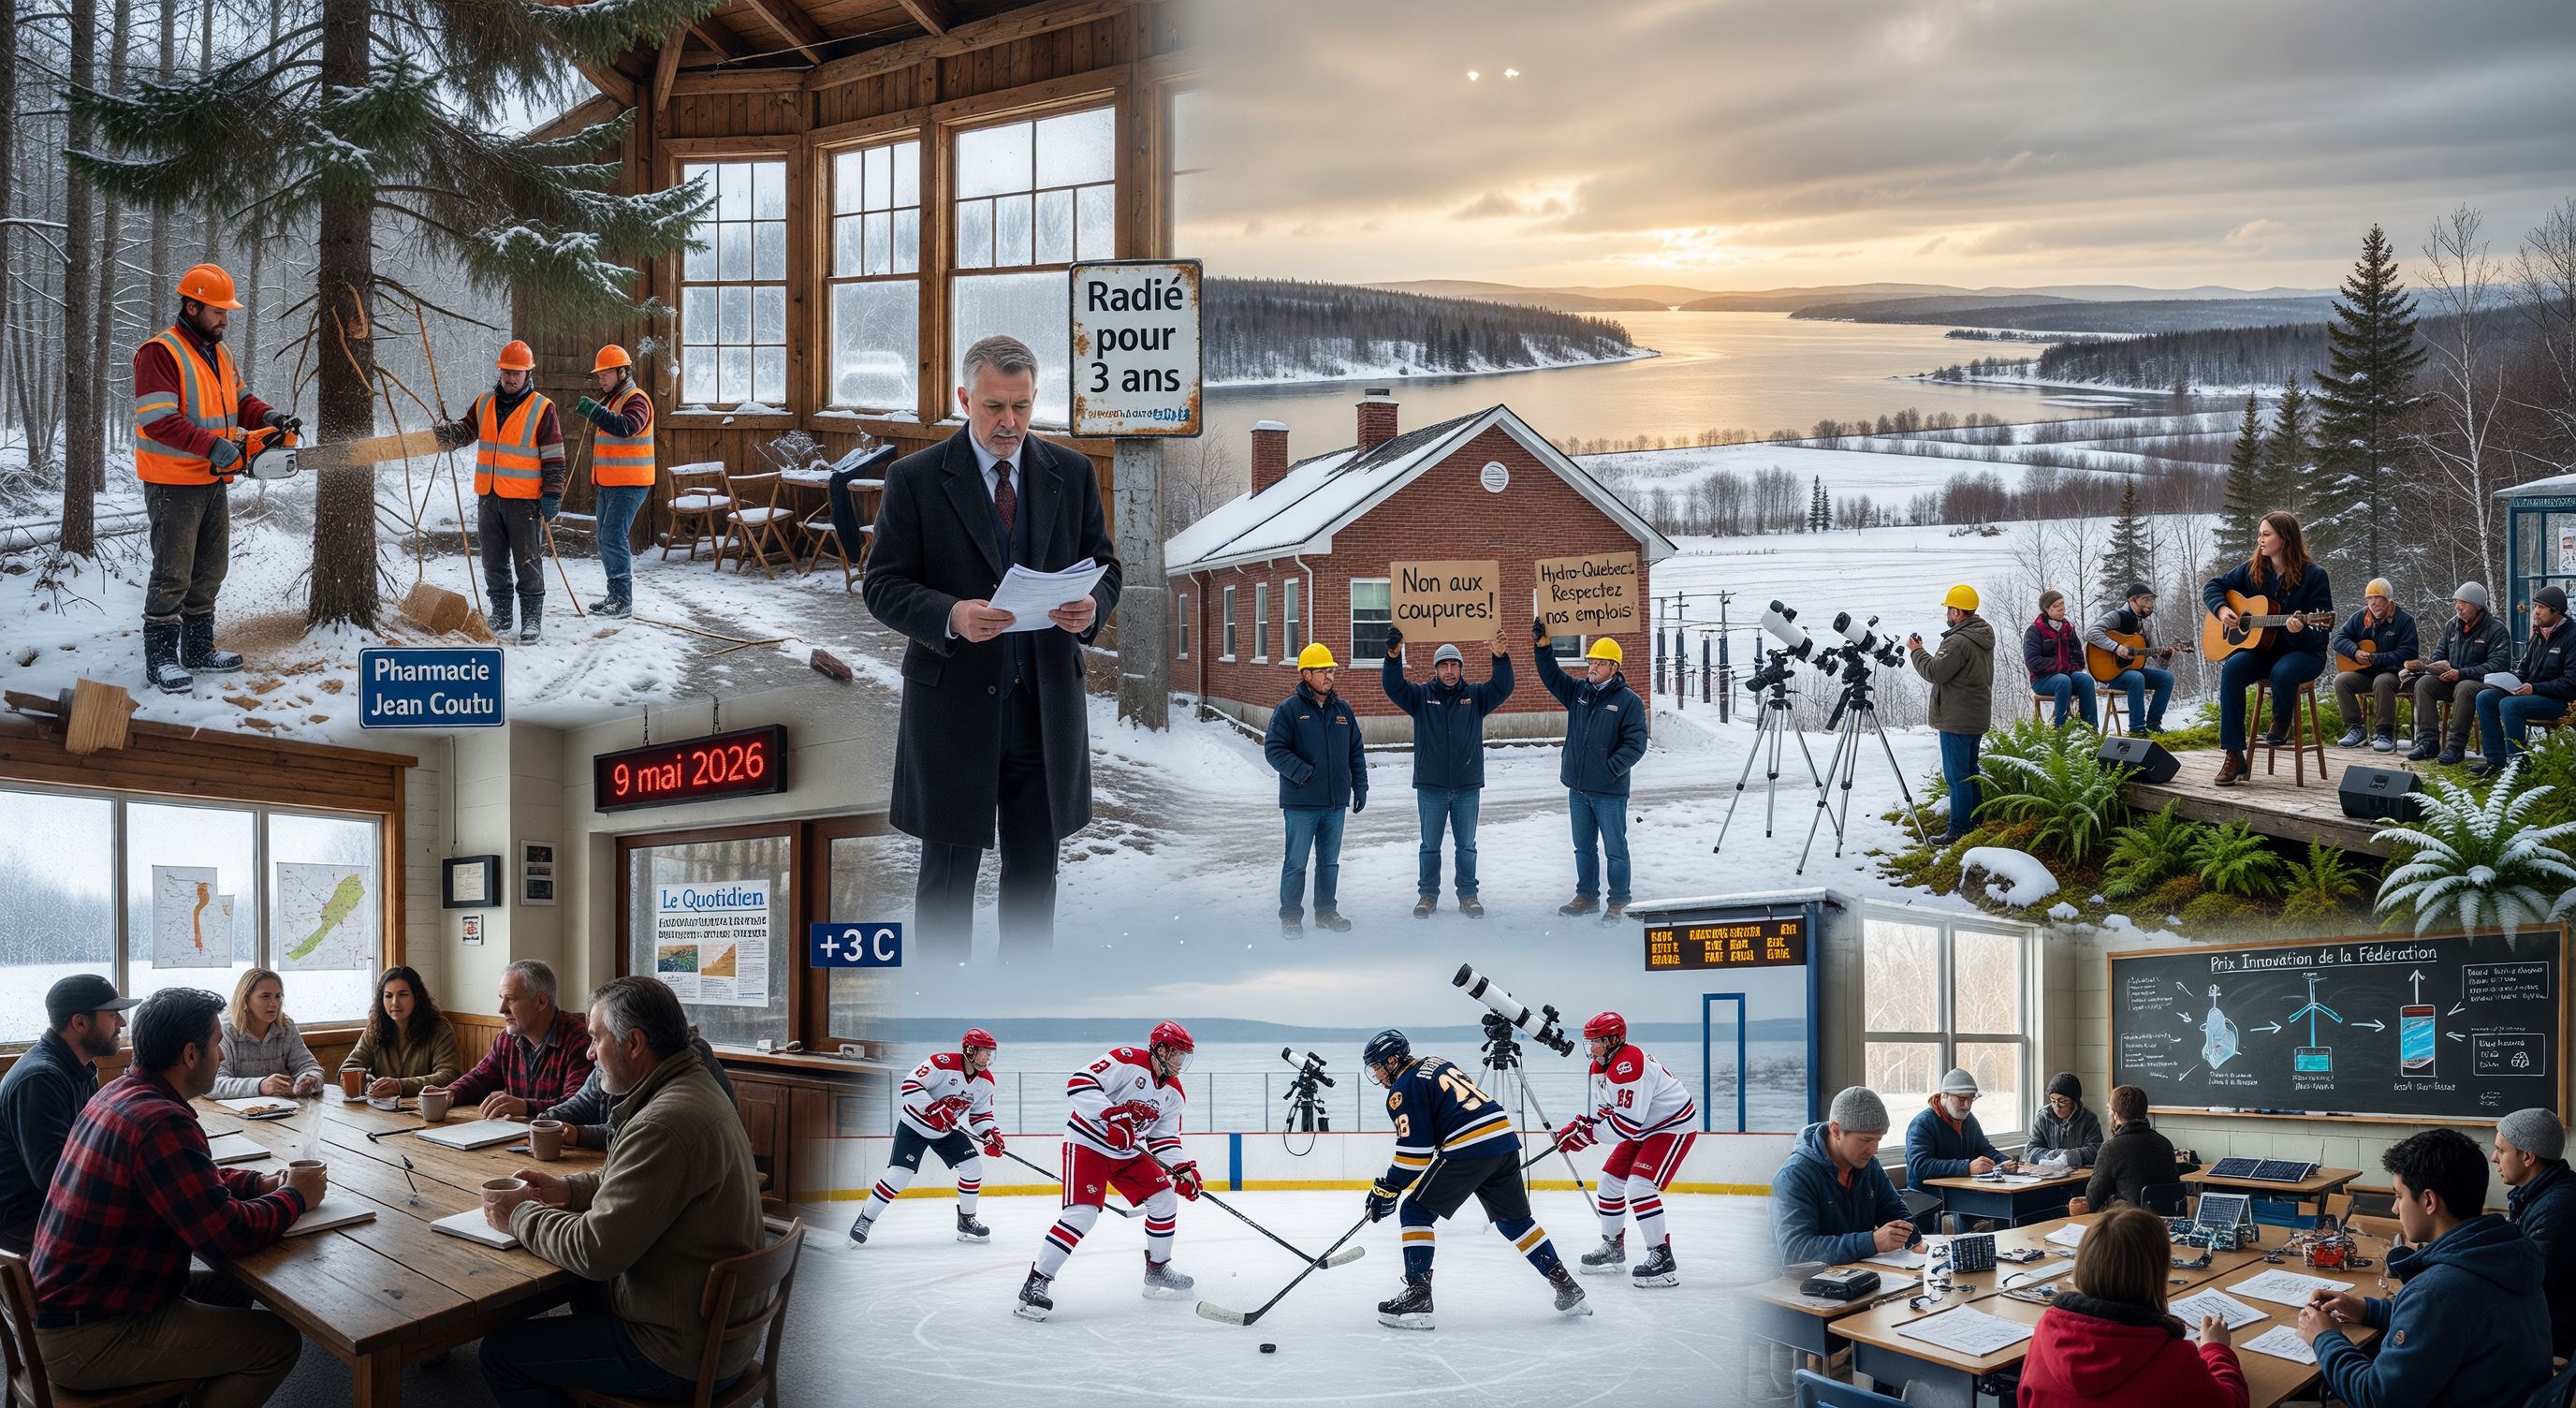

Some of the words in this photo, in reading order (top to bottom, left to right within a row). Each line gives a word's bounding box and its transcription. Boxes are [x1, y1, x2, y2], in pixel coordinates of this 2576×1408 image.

[1088, 272, 1183, 312] Radié
[1096, 328, 1177, 359] pour
[1090, 361, 1109, 393] 3
[1121, 369, 1181, 392] ans
[1403, 566, 1441, 594] Non
[1450, 576, 1483, 592] aux
[1551, 581, 1623, 605] Respectez
[1398, 592, 1494, 628] coupures!
[1545, 610, 1570, 625] nos
[374, 657, 490, 682] Pharmacie
[371, 693, 423, 716] Jean
[429, 692, 494, 715] Coutu
[614, 763, 630, 796] 9
[637, 754, 682, 793] mai
[692, 741, 765, 786] 2026
[663, 889, 678, 909] Le
[682, 887, 765, 913] Quotidien
[820, 928, 863, 962] +3
[872, 928, 895, 962] C
[2210, 956, 2236, 973] Prix
[2319, 948, 2334, 964] de
[2340, 946, 2352, 962] la
[2359, 945, 2437, 962] Fédération
